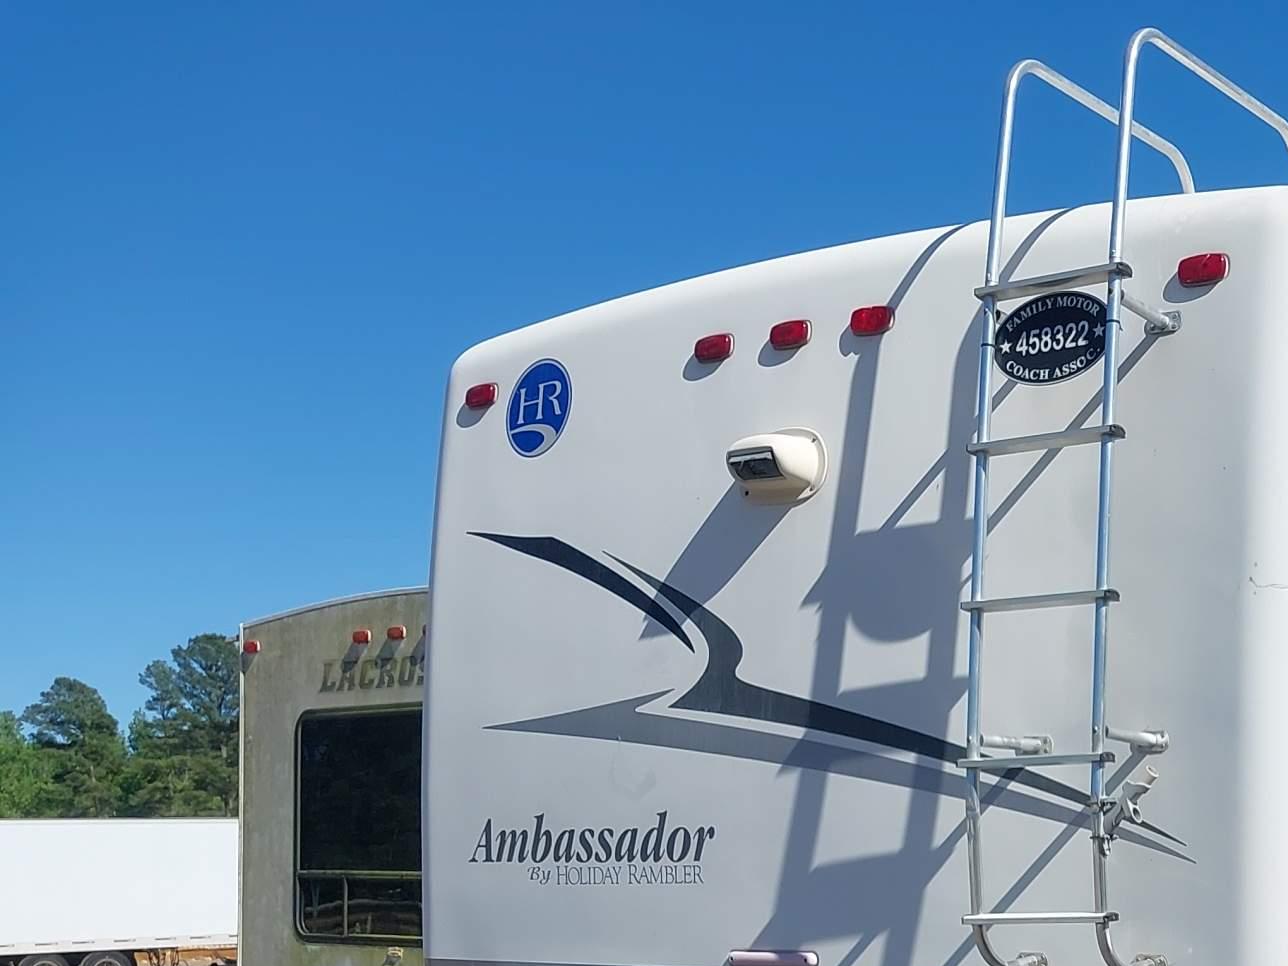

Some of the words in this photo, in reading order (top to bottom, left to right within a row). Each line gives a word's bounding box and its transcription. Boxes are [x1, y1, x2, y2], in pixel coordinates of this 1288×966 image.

[1006, 298, 1055, 332] FAMILY
[1056, 296, 1100, 317] MOTOR
[1015, 320, 1089, 357] 458322
[1006, 360, 1050, 380] COACH
[1053, 347, 1100, 378] ASSOC.
[516, 380, 562, 425] HR
[468, 810, 716, 863] Ambassador
[527, 866, 551, 885] By
[556, 864, 622, 886] HOLIDAY
[627, 863, 704, 885] RAMBLER
